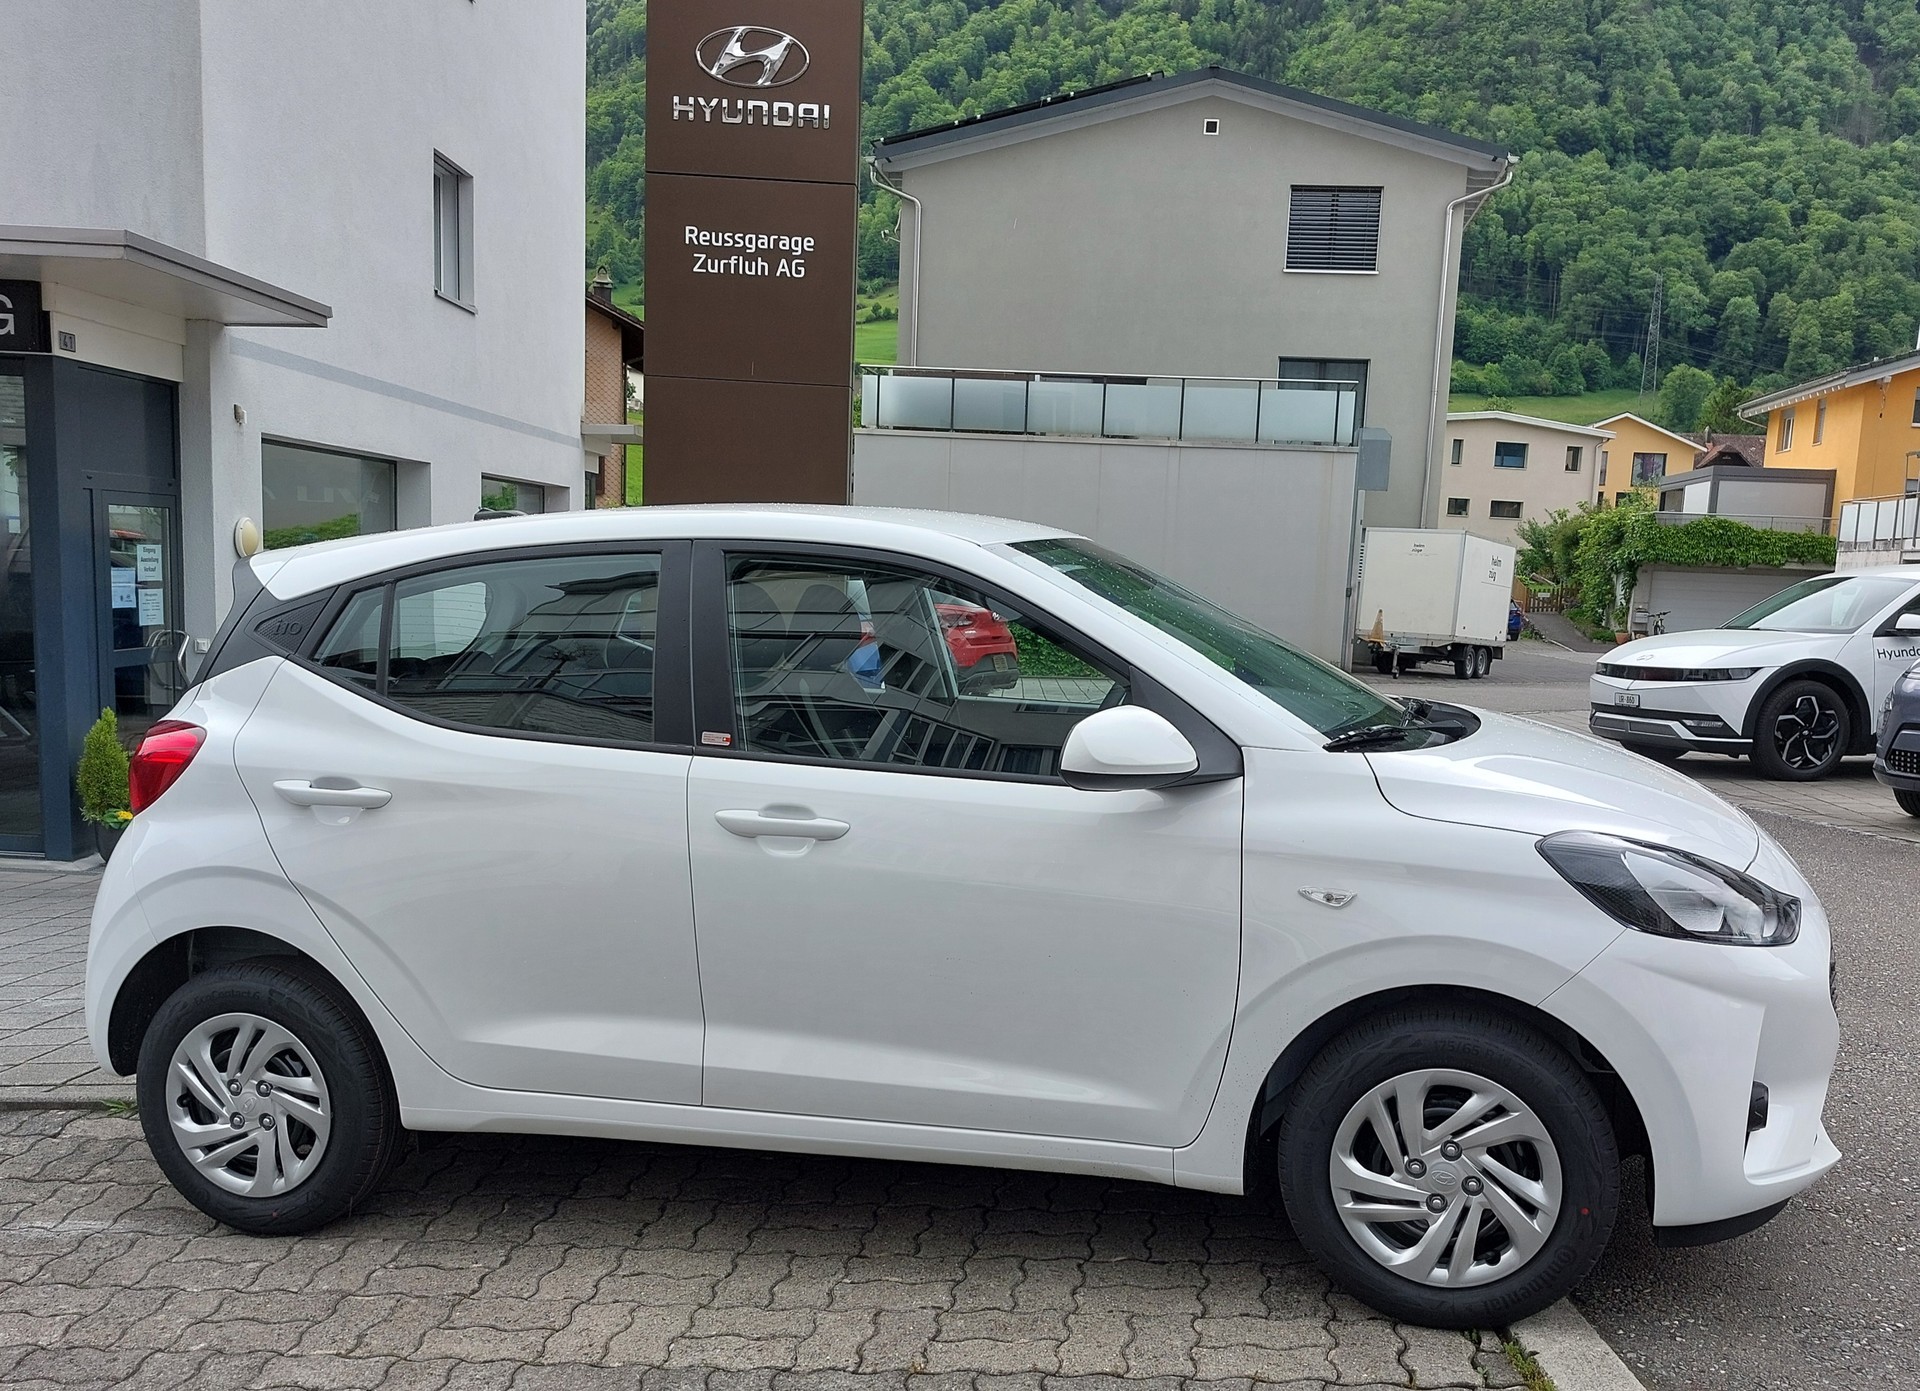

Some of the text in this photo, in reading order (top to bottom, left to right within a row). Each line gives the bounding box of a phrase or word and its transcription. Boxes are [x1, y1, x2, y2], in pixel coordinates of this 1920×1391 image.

[671, 95, 831, 130] HYUNDAI
[684, 225, 816, 256] Reussgarage
[692, 253, 806, 279] Zurfluh AG
[1433, 1039, 1481, 1057] 175/65
